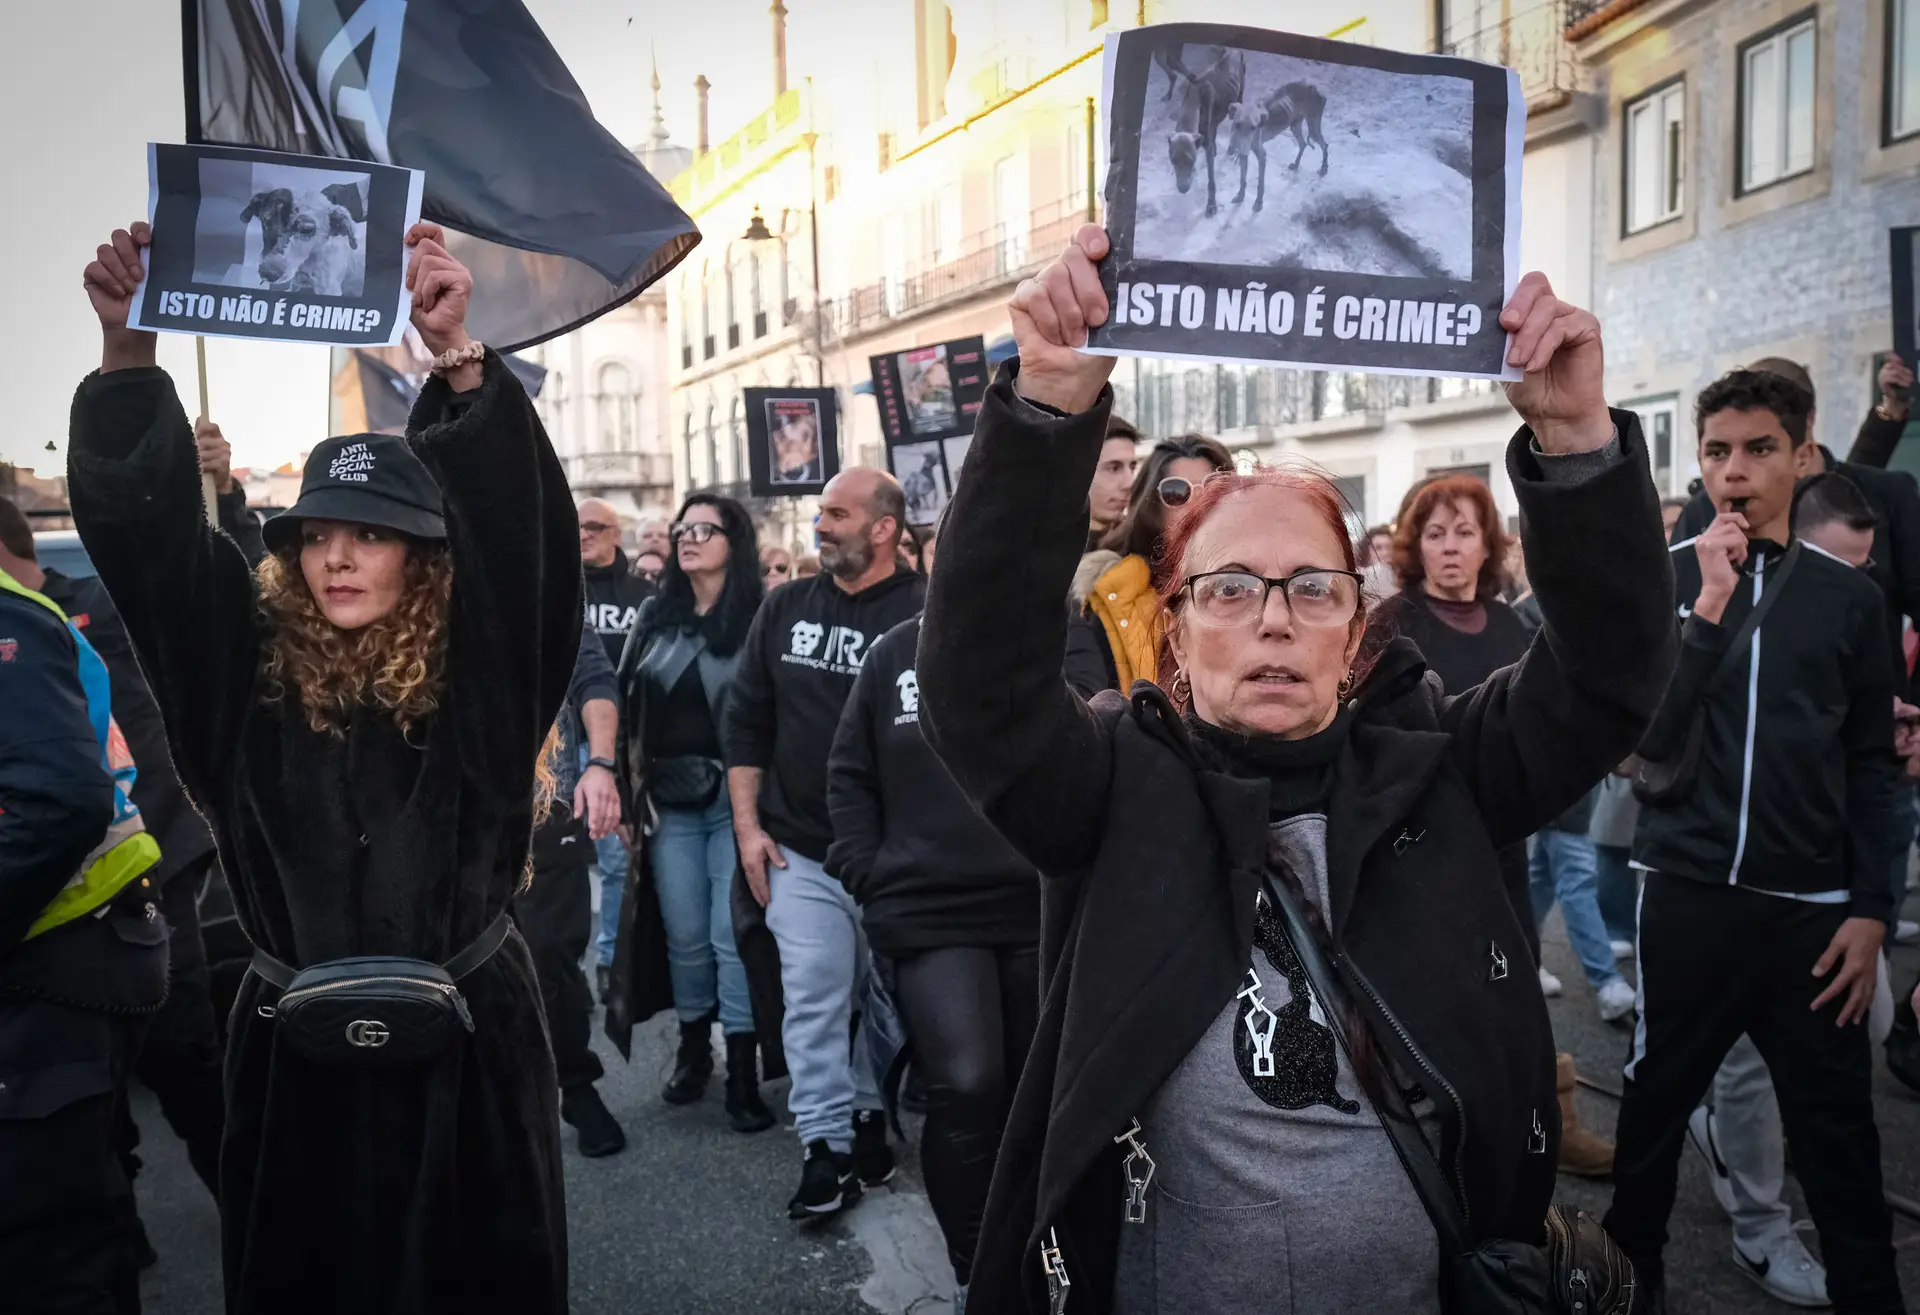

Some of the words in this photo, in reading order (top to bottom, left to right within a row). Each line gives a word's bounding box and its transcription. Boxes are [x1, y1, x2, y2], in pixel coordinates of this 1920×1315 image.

[159, 291, 215, 320] ISTO
[219, 294, 267, 324] NÃO
[272, 298, 287, 326] É
[290, 303, 381, 333] CRIME?
[1115, 282, 1205, 329] ISTO
[1214, 281, 1295, 336] NÃO
[1303, 286, 1326, 337] É
[1333, 296, 1482, 346] CRIME?
[340, 443, 368, 458] ANTI
[331, 452, 376, 468] SOCIAL
[329, 461, 375, 477] SOCIAL
[339, 473, 369, 482] CLUB
[589, 603, 639, 630] IRA
